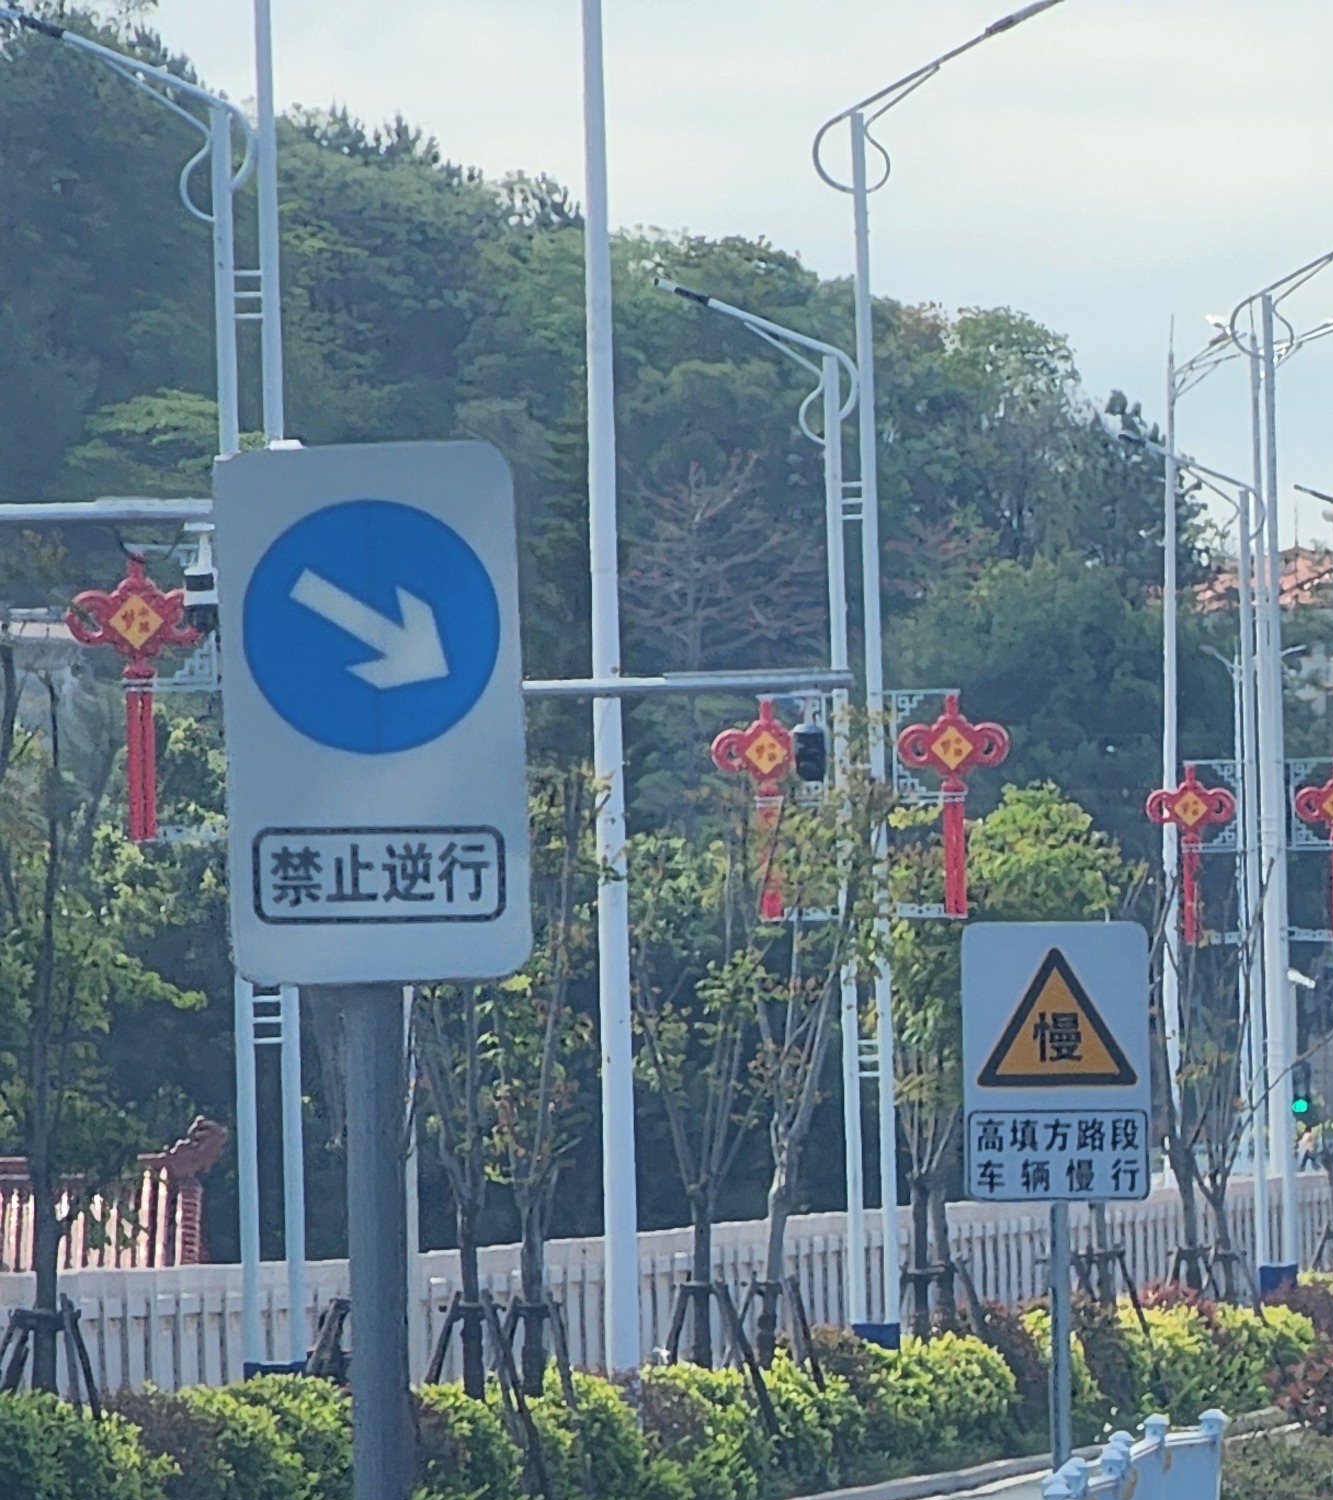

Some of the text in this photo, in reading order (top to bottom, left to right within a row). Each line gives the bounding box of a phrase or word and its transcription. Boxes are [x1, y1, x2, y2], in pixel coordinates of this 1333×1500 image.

[270, 841, 491, 907] 禁止逆行
[1033, 1011, 1083, 1062] 慢
[976, 1117, 1140, 1152] 高填方路段
[977, 1158, 1140, 1193] 车辆慢行
